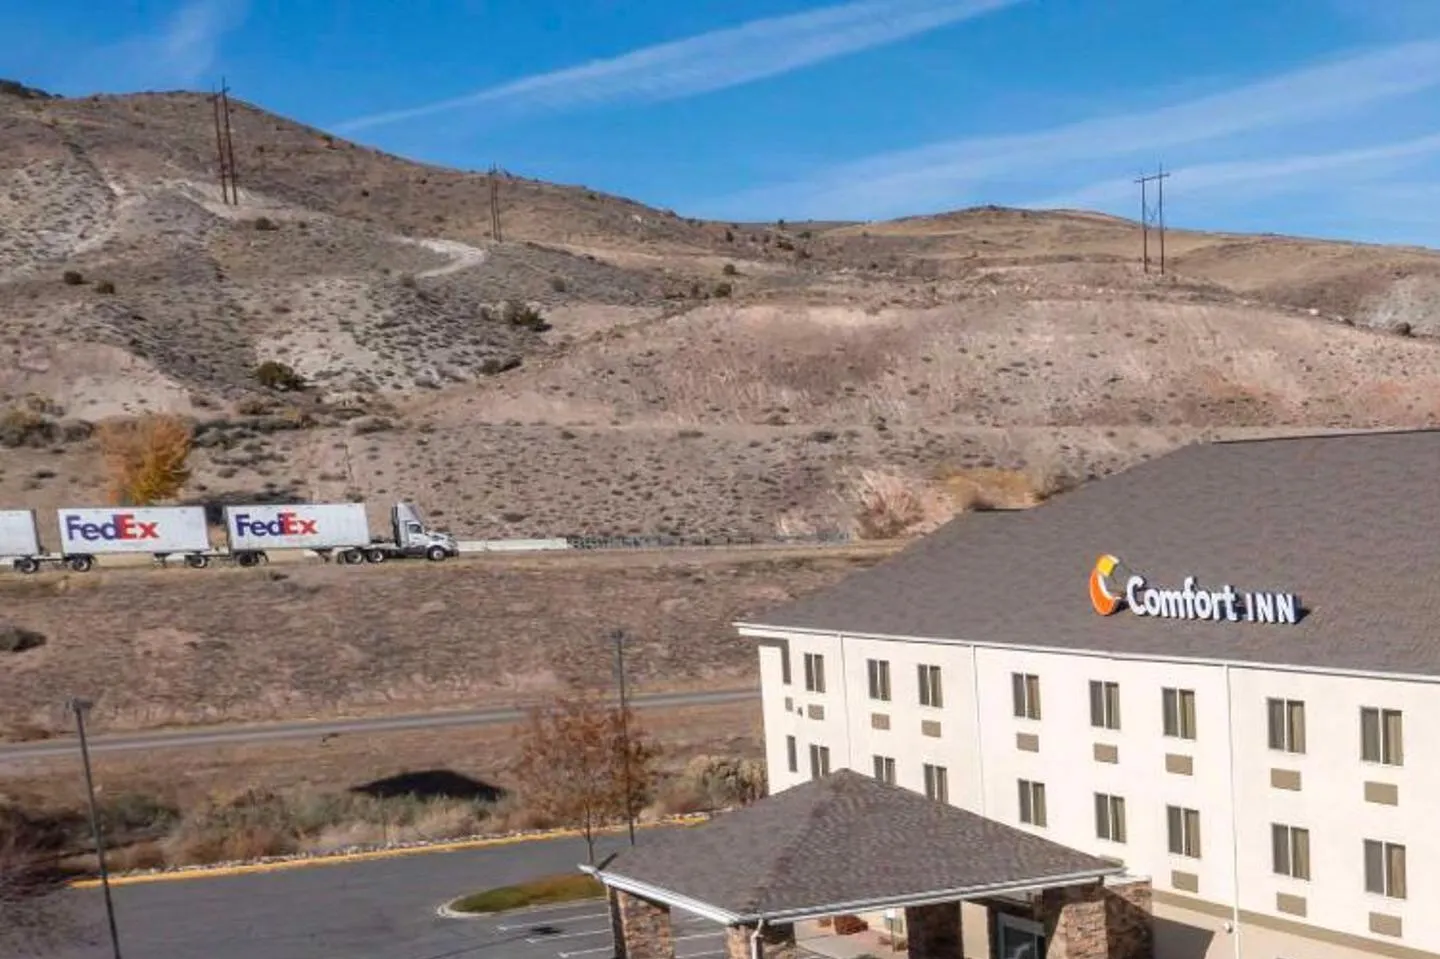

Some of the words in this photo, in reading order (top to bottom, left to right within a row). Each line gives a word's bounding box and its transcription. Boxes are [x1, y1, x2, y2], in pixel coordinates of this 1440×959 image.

[66, 514, 159, 540] FedEx
[236, 512, 318, 537] FedEx
[1126, 575, 1238, 621] Comfort
[1245, 592, 1298, 624] INN
